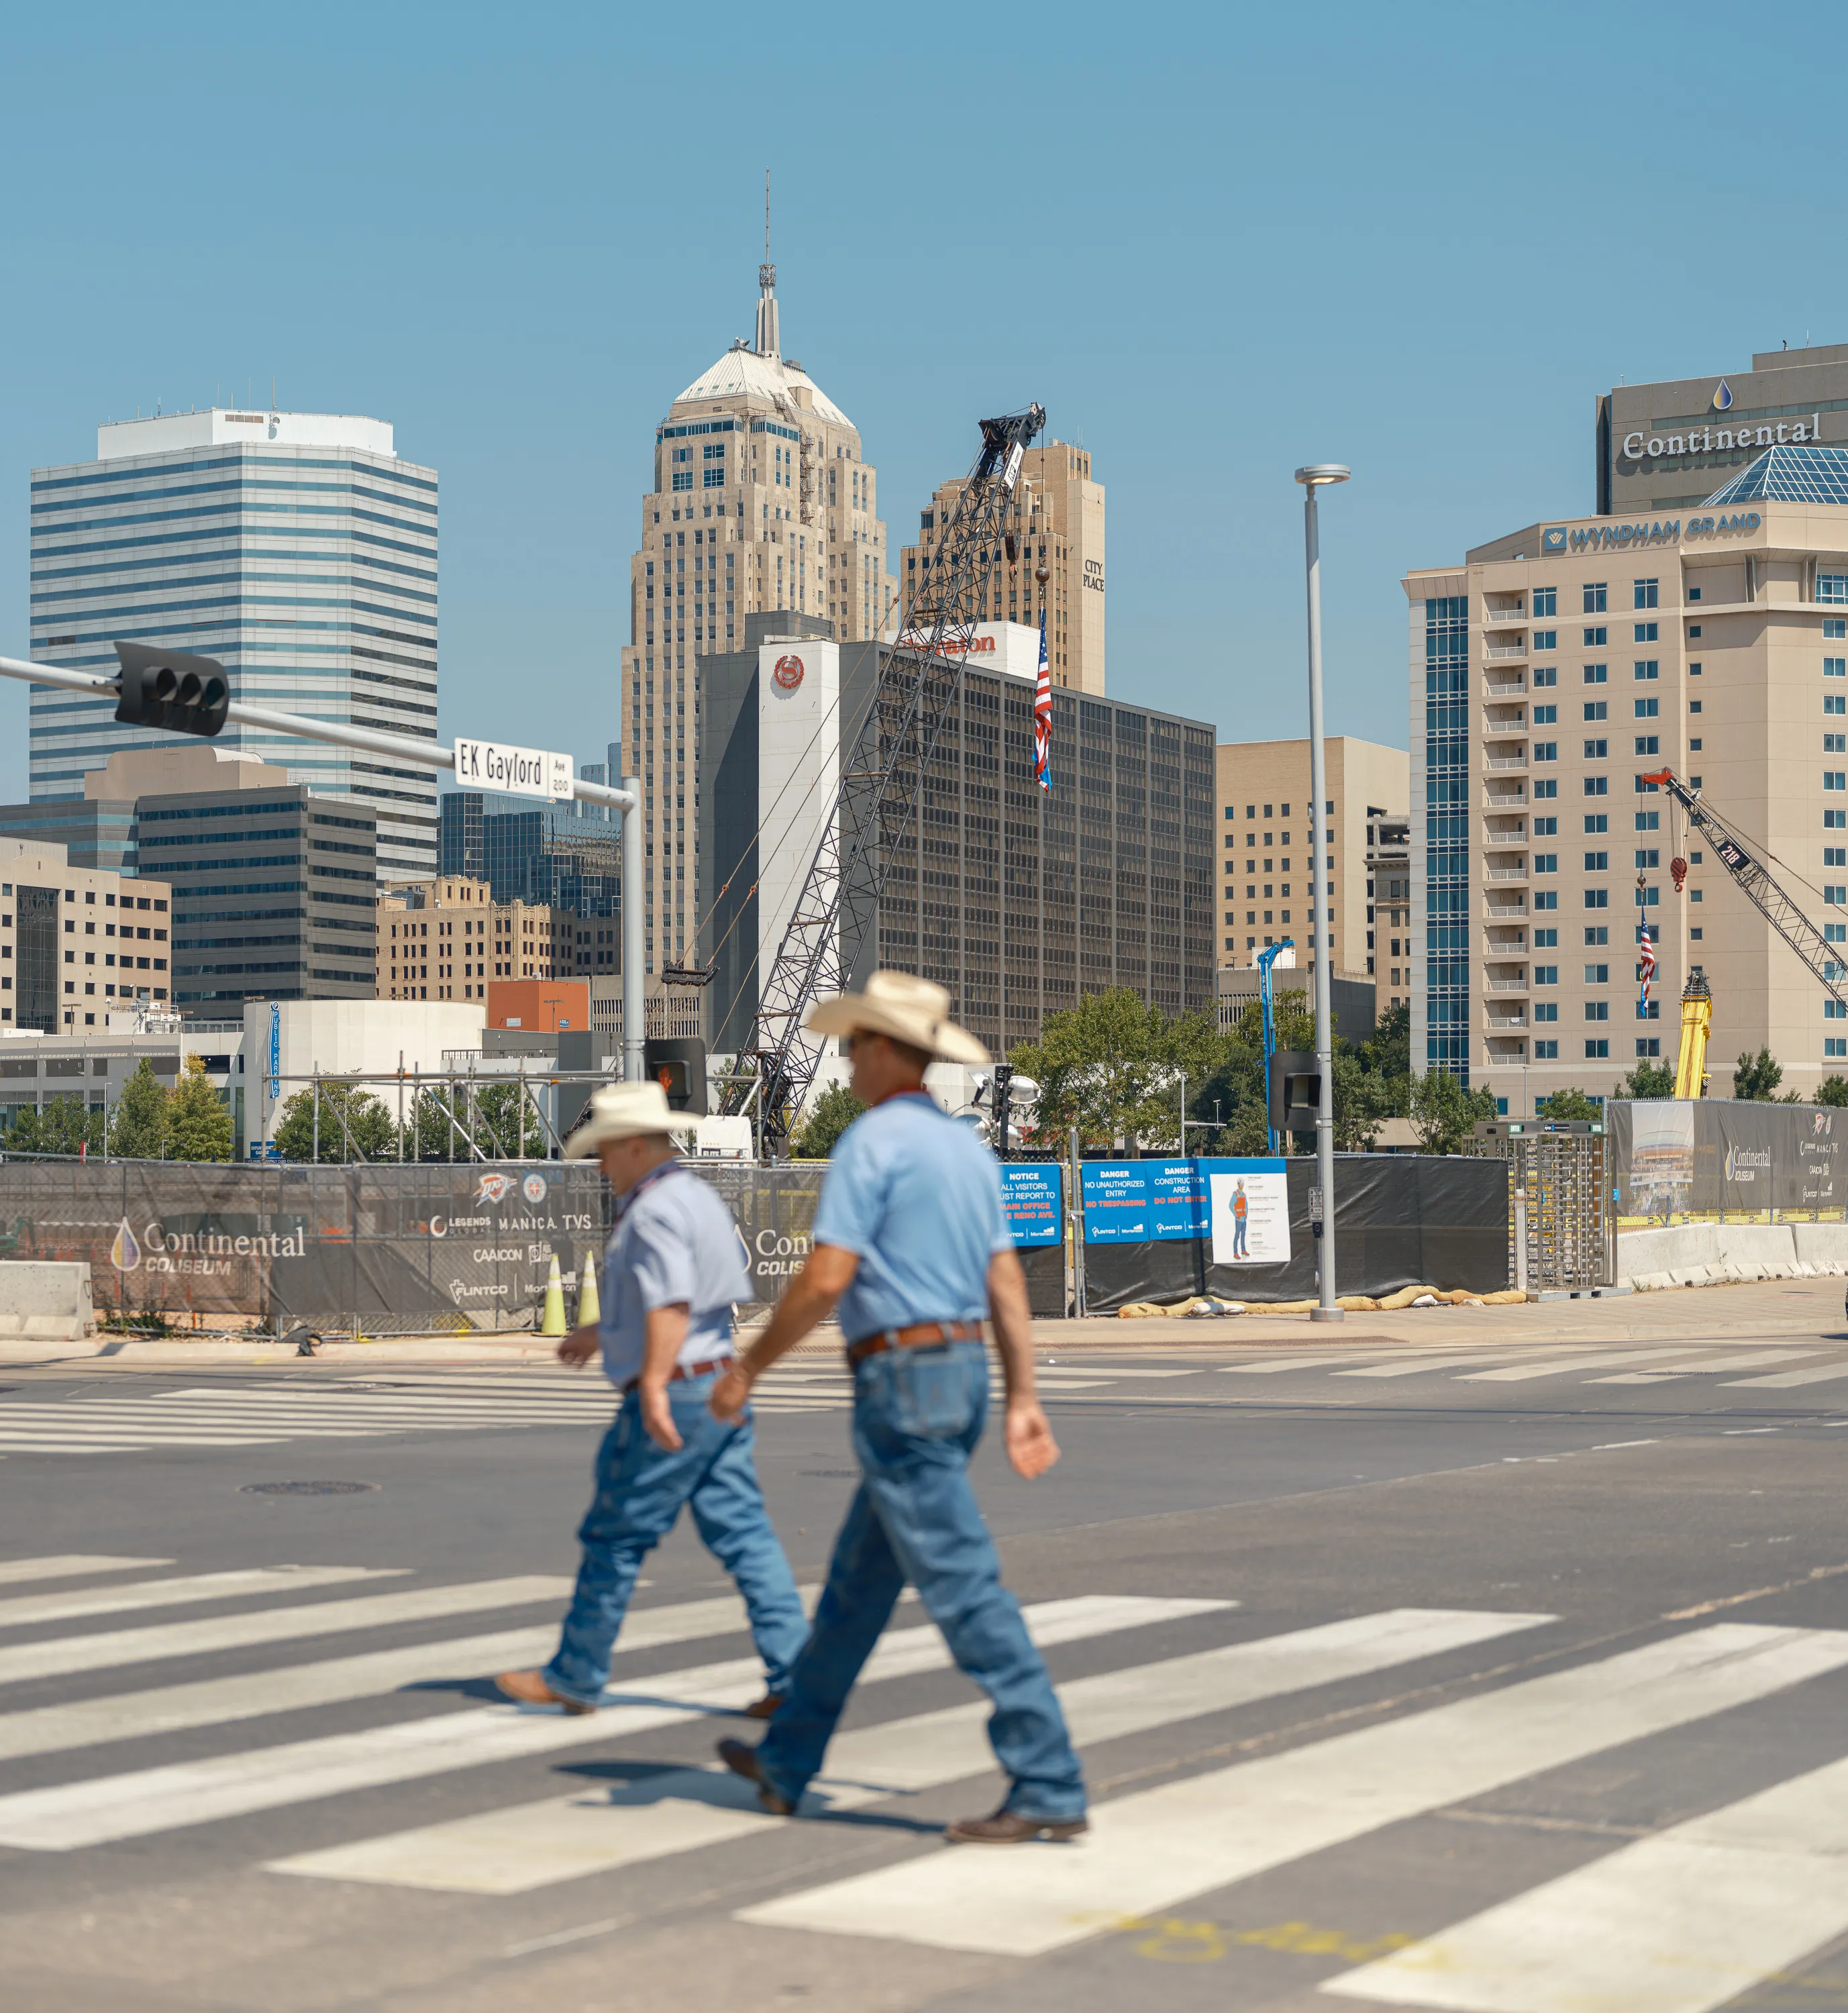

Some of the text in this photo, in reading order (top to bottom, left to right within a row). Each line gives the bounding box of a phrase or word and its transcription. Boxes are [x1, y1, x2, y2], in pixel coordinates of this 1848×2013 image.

[1623, 412, 1822, 460] Continental
[1572, 512, 1762, 545] WYNDHAM GRAND
[1085, 559, 1102, 575] CITY
[1083, 574, 1105, 592] PLACE
[460, 743, 542, 789] EK Gaylord
[554, 760, 566, 772] Ave
[553, 779, 569, 792] 200
[1721, 845, 1740, 864] 218
[1733, 1145, 1771, 1167] Continental
[1009, 1172, 1039, 1181] NOTICE
[1100, 1170, 1129, 1178] DANGER
[1164, 1167, 1194, 1175] DANGER
[1000, 1182, 1048, 1191] ALL VISITORS
[1096, 1180, 1145, 1188] UNAUTHORIZED
[1154, 1176, 1205, 1186] CONSTRUCTION
[999, 1191, 1056, 1200] UST REPORT TO
[1172, 1186, 1190, 1194] AREA
[1098, 1199, 1146, 1207] TRESPASSING
[1184, 1195, 1207, 1203] ENTER
[1022, 1202, 1051, 1210] OFFICE
[448, 1217, 491, 1227] LEGENDS
[498, 1217, 558, 1231] MANICA
[562, 1214, 592, 1231] TVS
[143, 1223, 306, 1258] Continental
[473, 1248, 523, 1263] CAAICON
[145, 1256, 232, 1276] COLISEUM
[455, 1284, 509, 1296] FLINTCO
